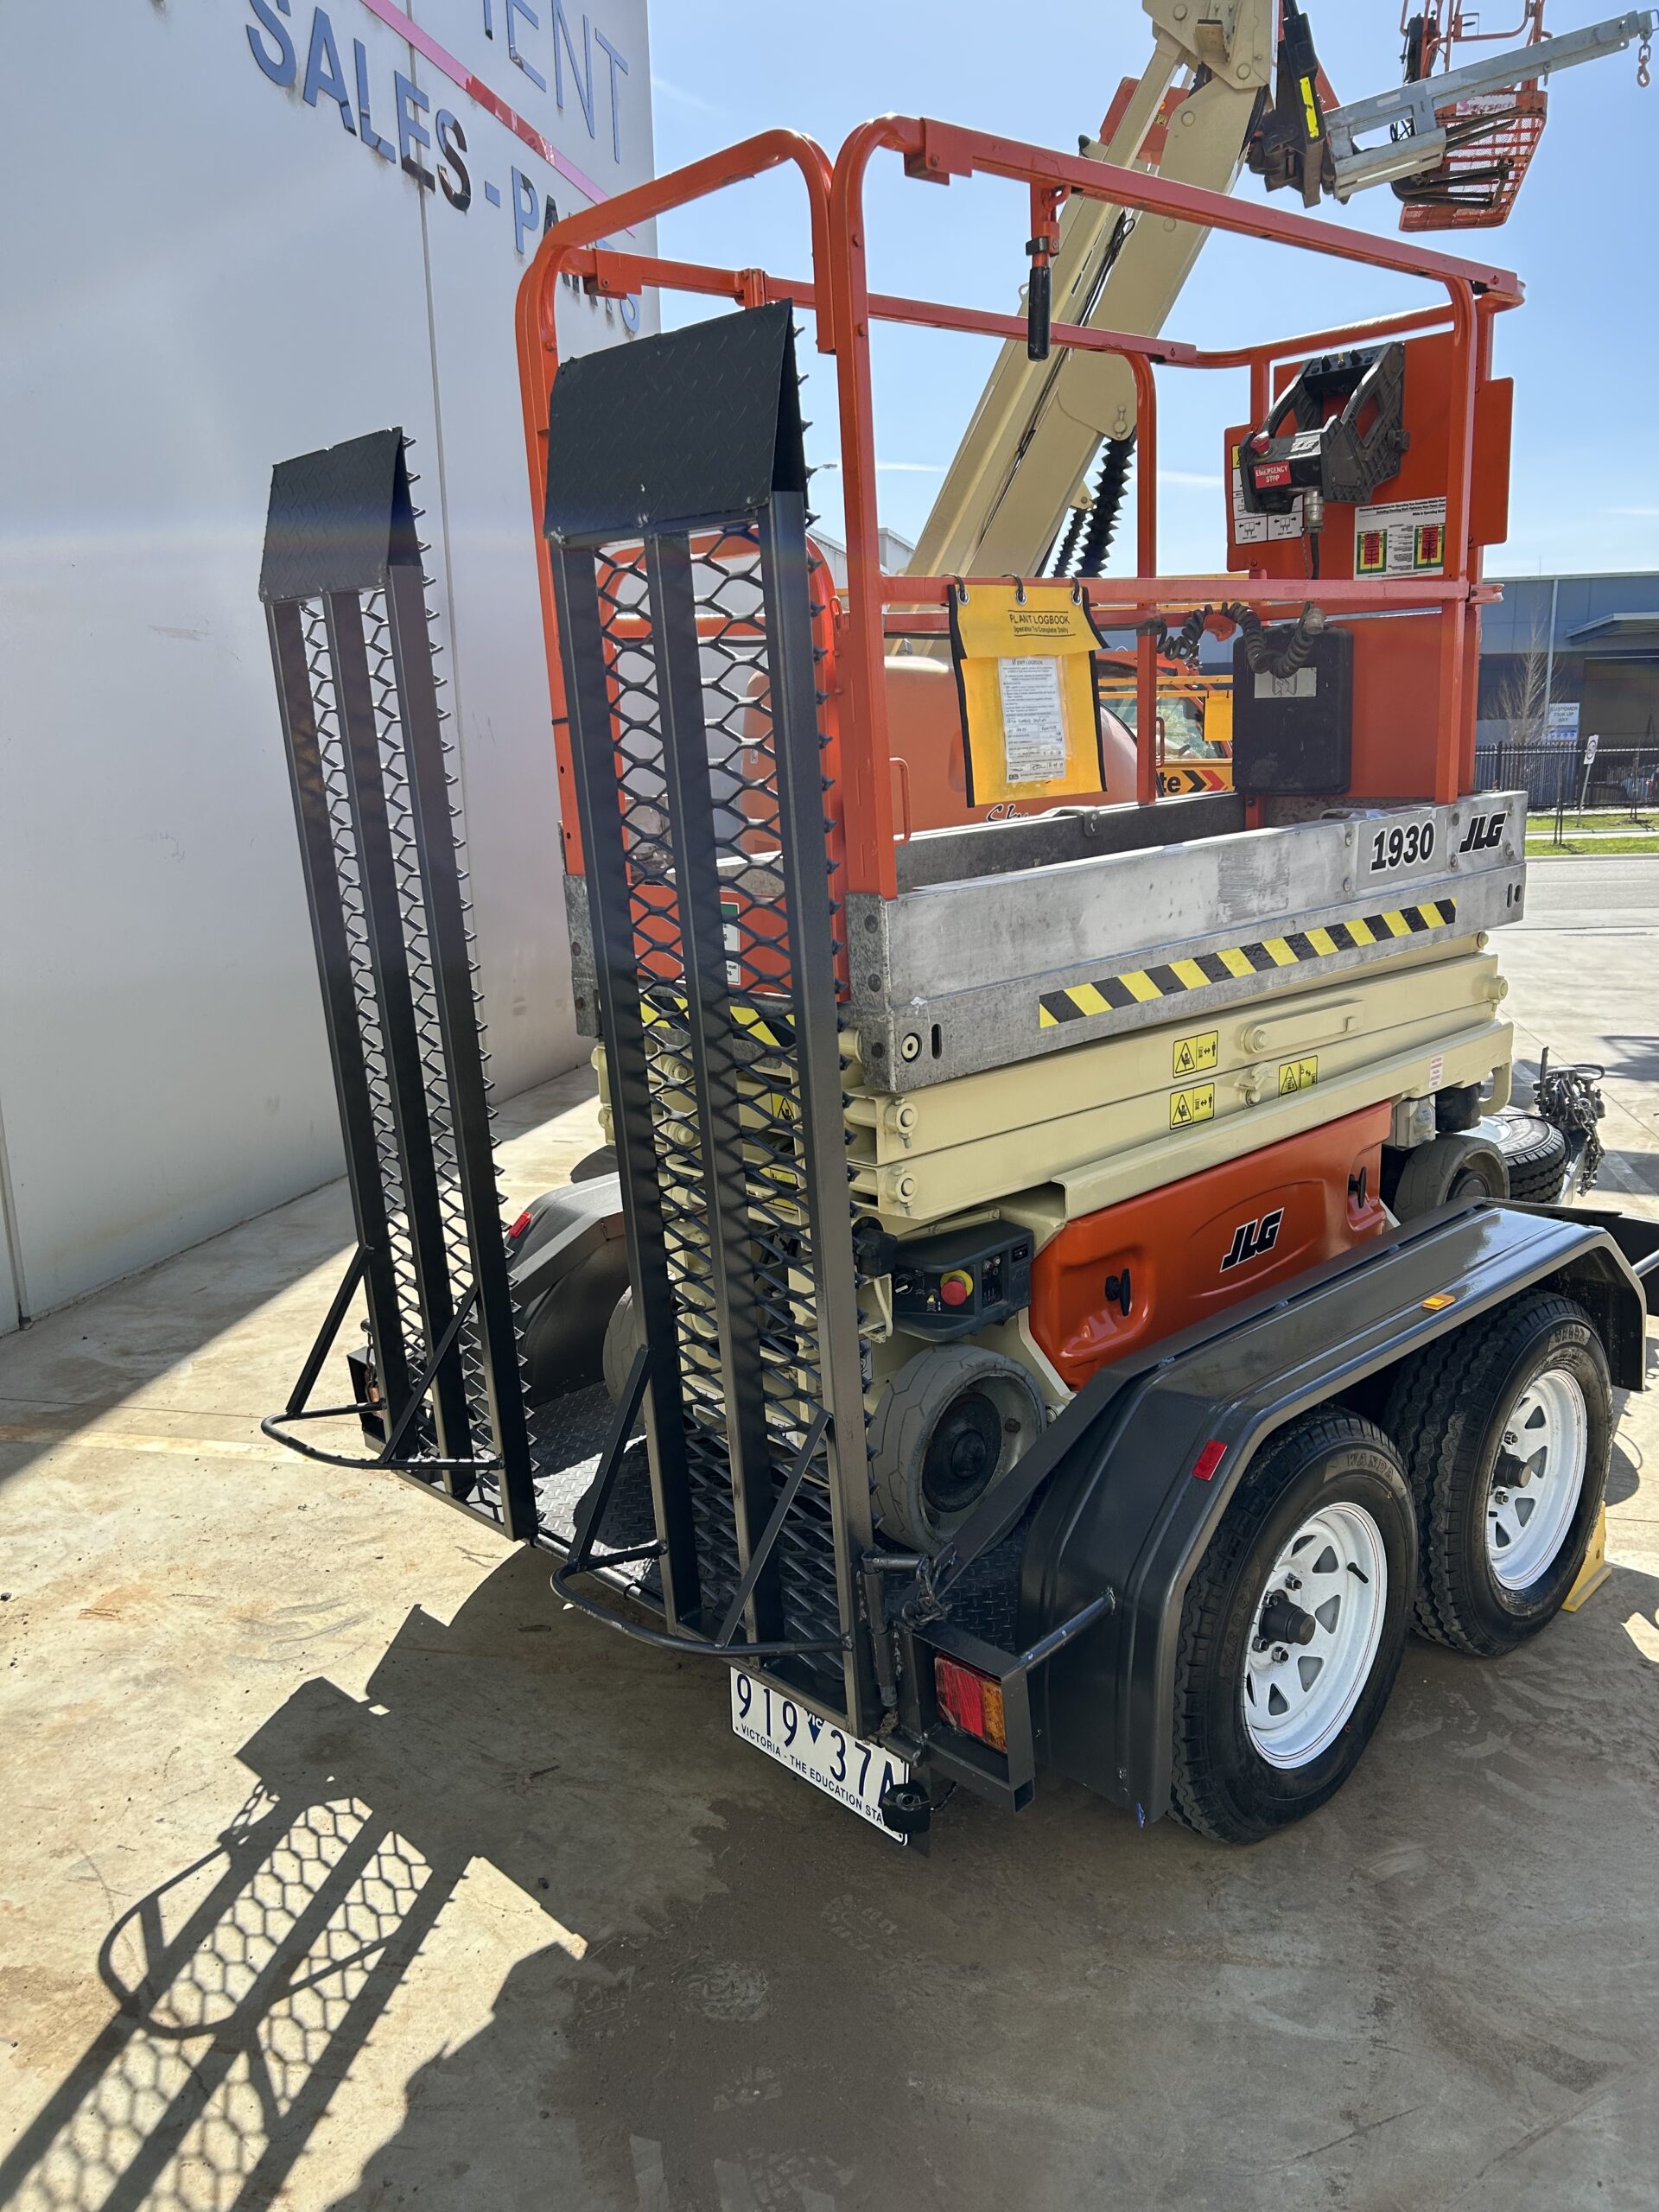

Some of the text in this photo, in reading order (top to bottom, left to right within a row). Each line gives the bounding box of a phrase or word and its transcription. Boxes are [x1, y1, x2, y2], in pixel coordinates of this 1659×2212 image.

[245, 0, 472, 213] SALES
[1009, 614, 1071, 625] PLANT LOGBOOK
[1370, 821, 1434, 873] 1930
[1458, 810, 1508, 855] JLG
[1219, 1207, 1284, 1273] JLG
[1348, 1452, 1394, 1482] WANDA
[737, 1673, 798, 1747] 919
[741, 1723, 781, 1758] VICTORIA
[790, 1753, 807, 1775] THE
[810, 1768, 862, 1811] EDUCATION
[865, 1805, 883, 1825] STA
